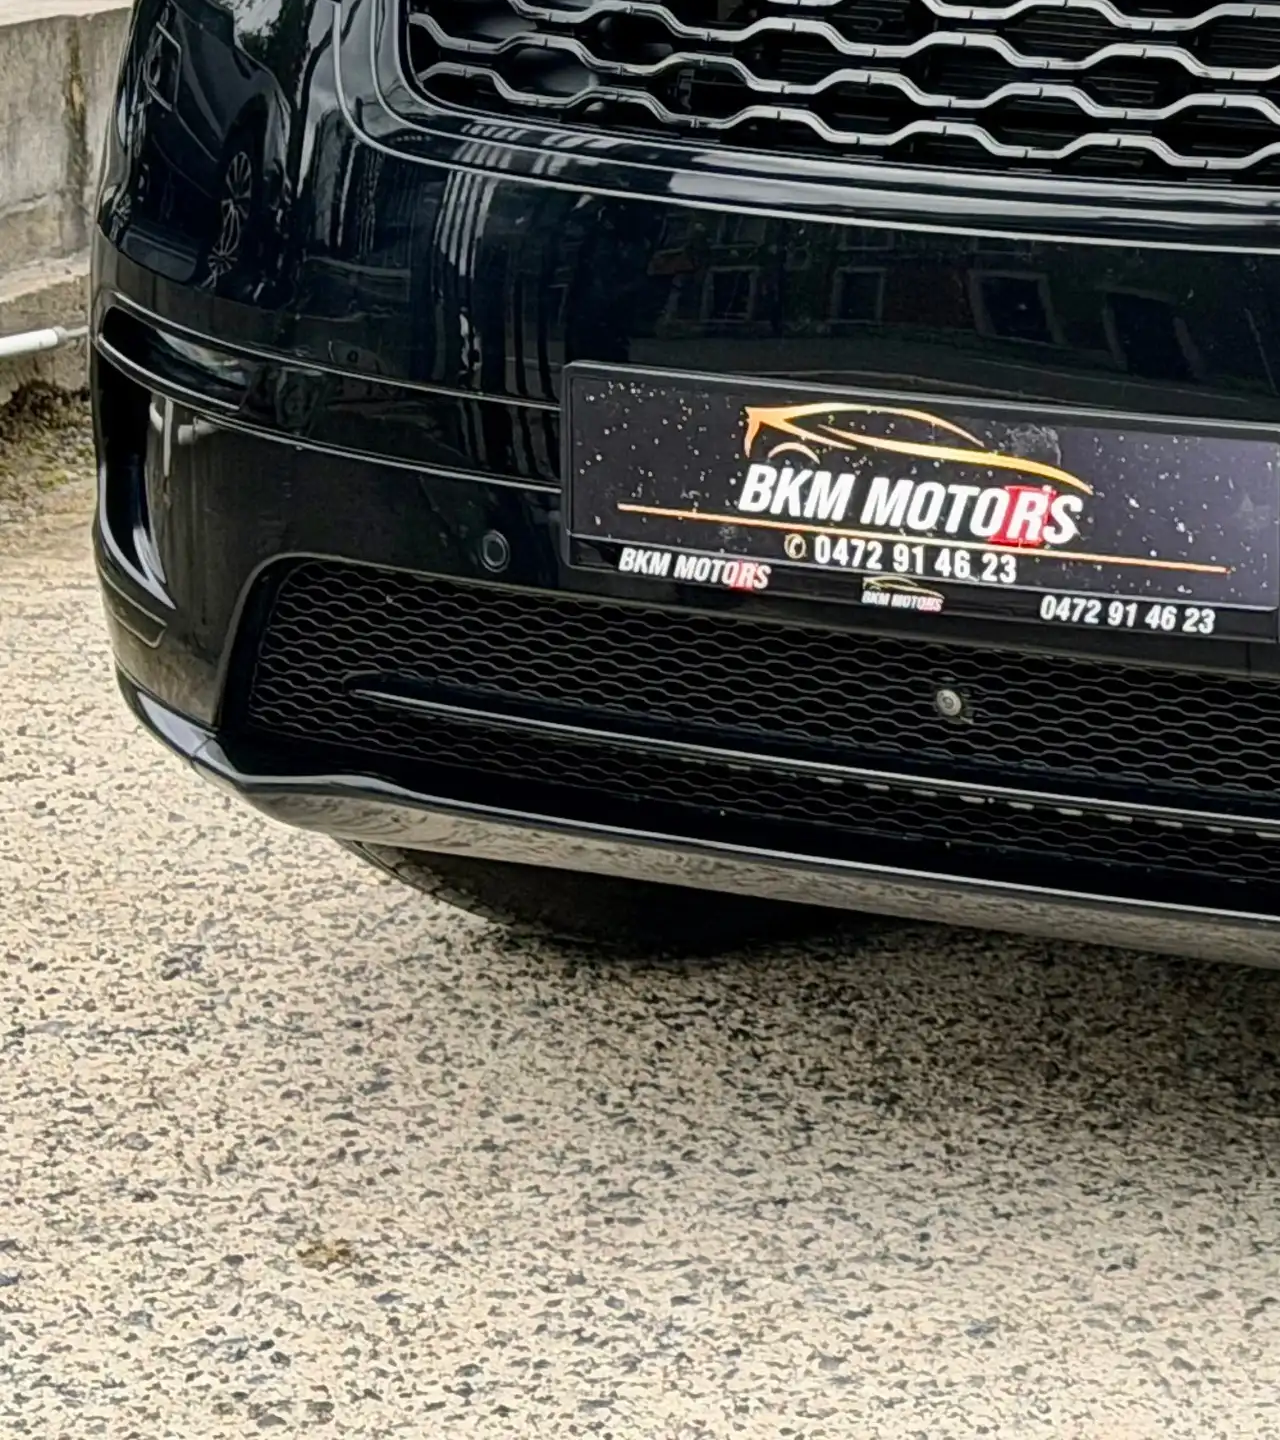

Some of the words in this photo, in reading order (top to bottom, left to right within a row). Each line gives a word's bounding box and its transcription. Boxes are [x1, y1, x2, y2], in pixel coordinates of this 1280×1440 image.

[738, 463, 856, 522] BKM
[859, 476, 1084, 545] MOTORS
[618, 547, 672, 577] BKM
[673, 554, 772, 589] MOTORS
[814, 535, 883, 571] 0472
[893, 544, 925, 574] 91
[935, 548, 971, 579] 46
[981, 553, 1017, 584] 23
[861, 590, 891, 606] BKM
[891, 594, 944, 612] MOTORS
[1039, 594, 1102, 624] 0472
[1107, 601, 1138, 628] 91
[1145, 604, 1178, 631] 46
[1182, 607, 1216, 634] 23
